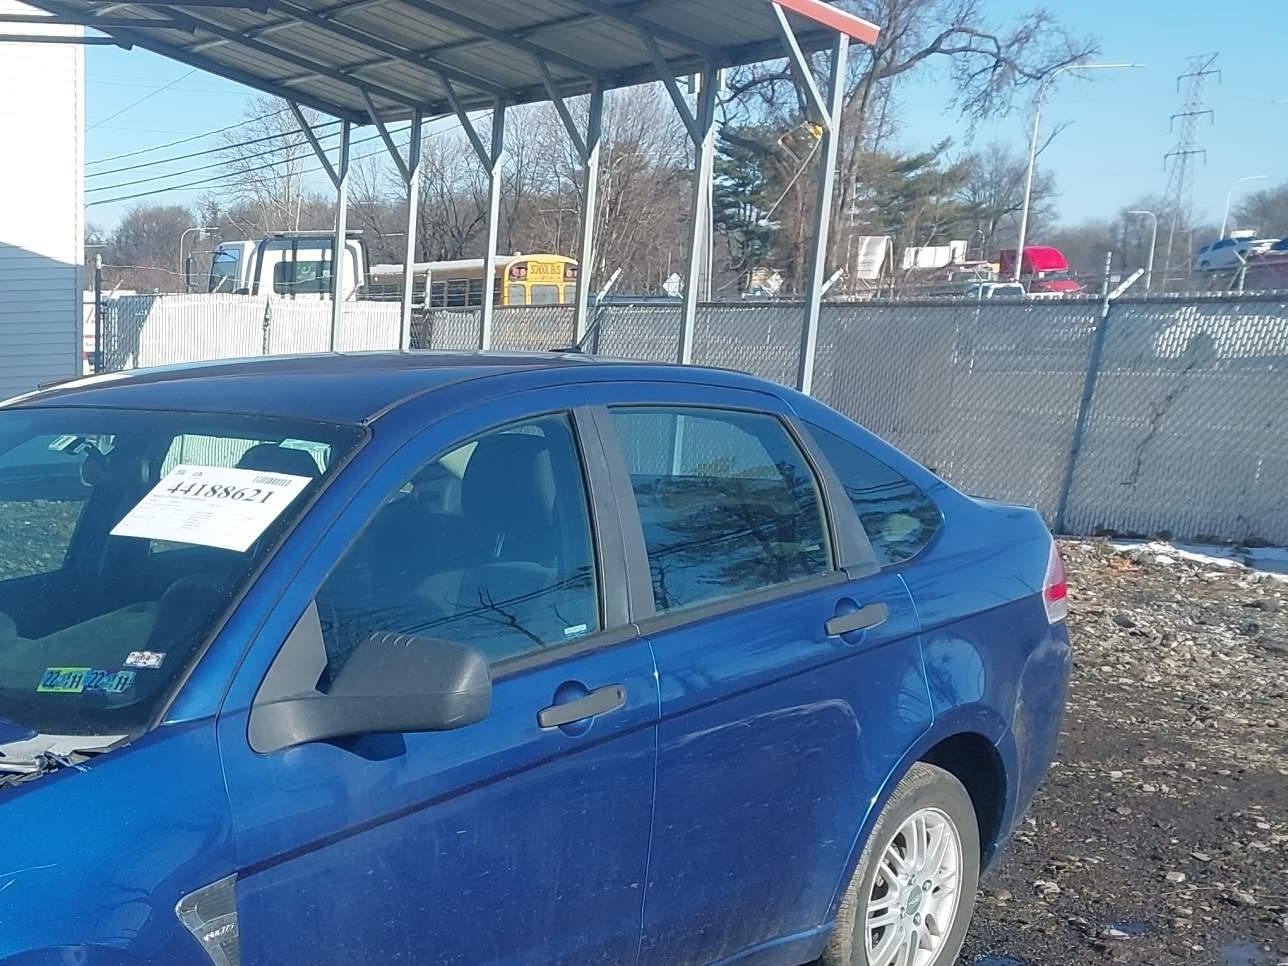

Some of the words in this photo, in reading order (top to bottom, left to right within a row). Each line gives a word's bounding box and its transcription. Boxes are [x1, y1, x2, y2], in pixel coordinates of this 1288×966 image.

[530, 264, 549, 274] SCHOOL
[550, 264, 561, 274] BUS
[167, 481, 275, 504] 44188621
